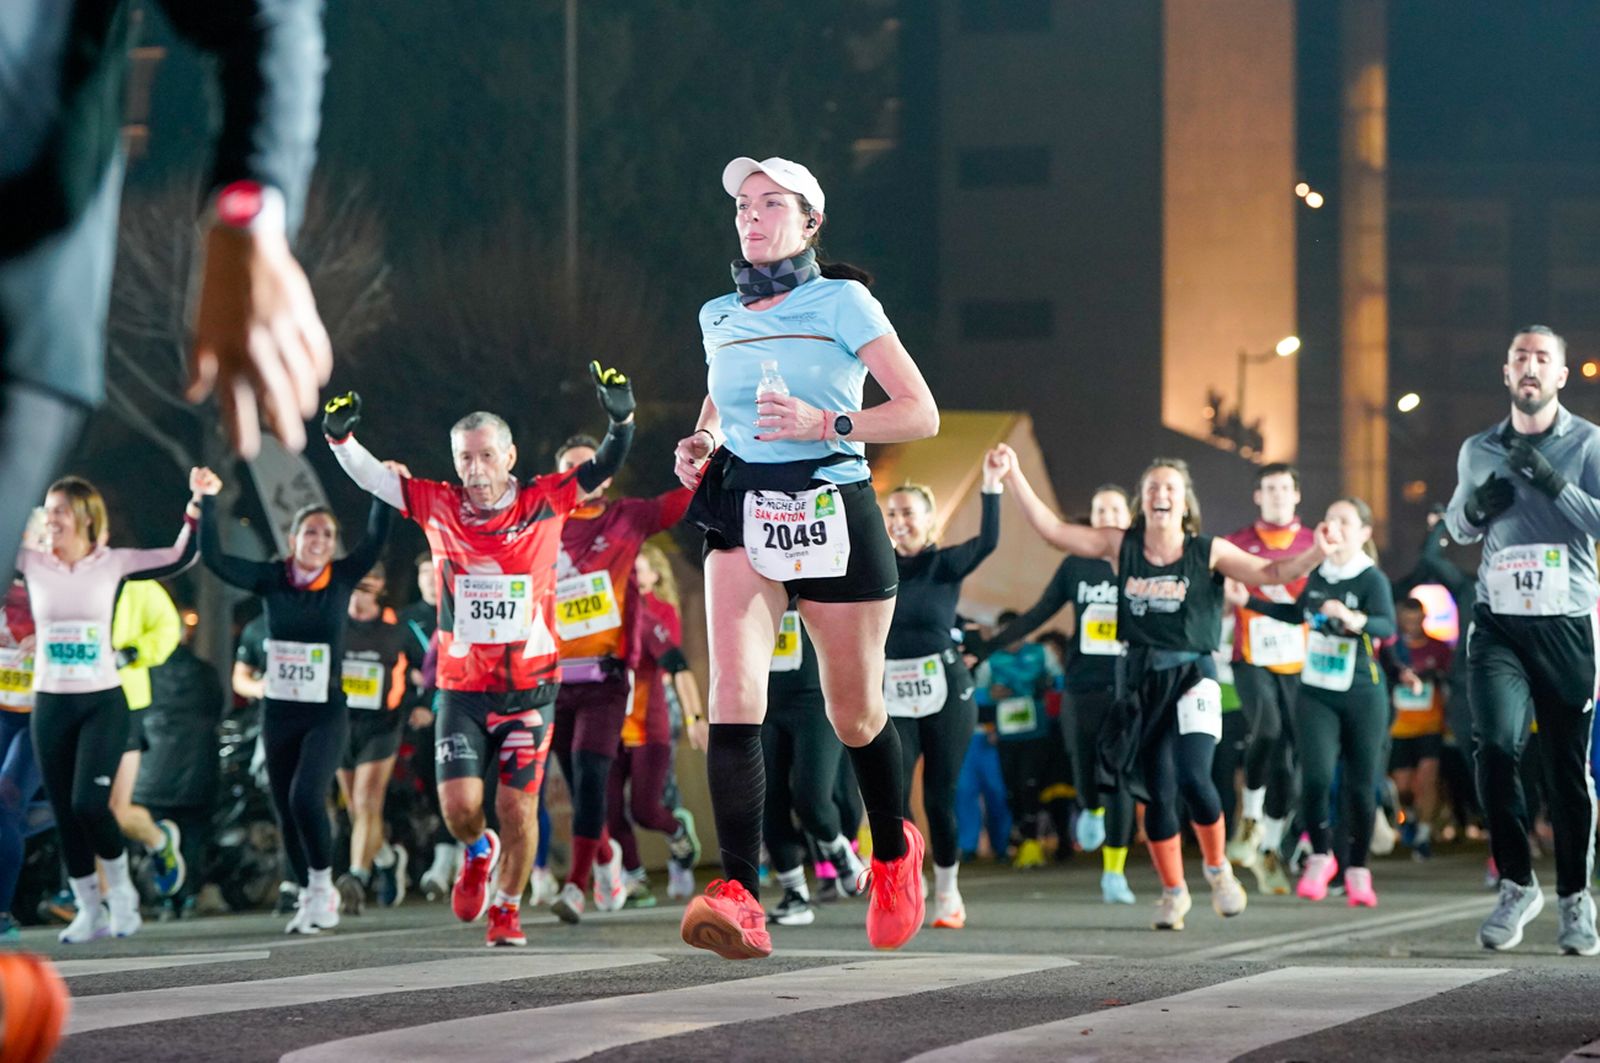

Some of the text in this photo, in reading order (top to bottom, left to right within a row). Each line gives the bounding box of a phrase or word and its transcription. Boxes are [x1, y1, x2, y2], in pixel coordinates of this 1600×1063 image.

[755, 509, 771, 519] SAN
[795, 501, 807, 510] DE
[763, 520, 828, 551] 2049
[1512, 570, 1544, 590] 147
[470, 600, 516, 620] 3547
[563, 595, 602, 618] 2120
[775, 633, 787, 650] 8
[278, 663, 315, 681] 5215
